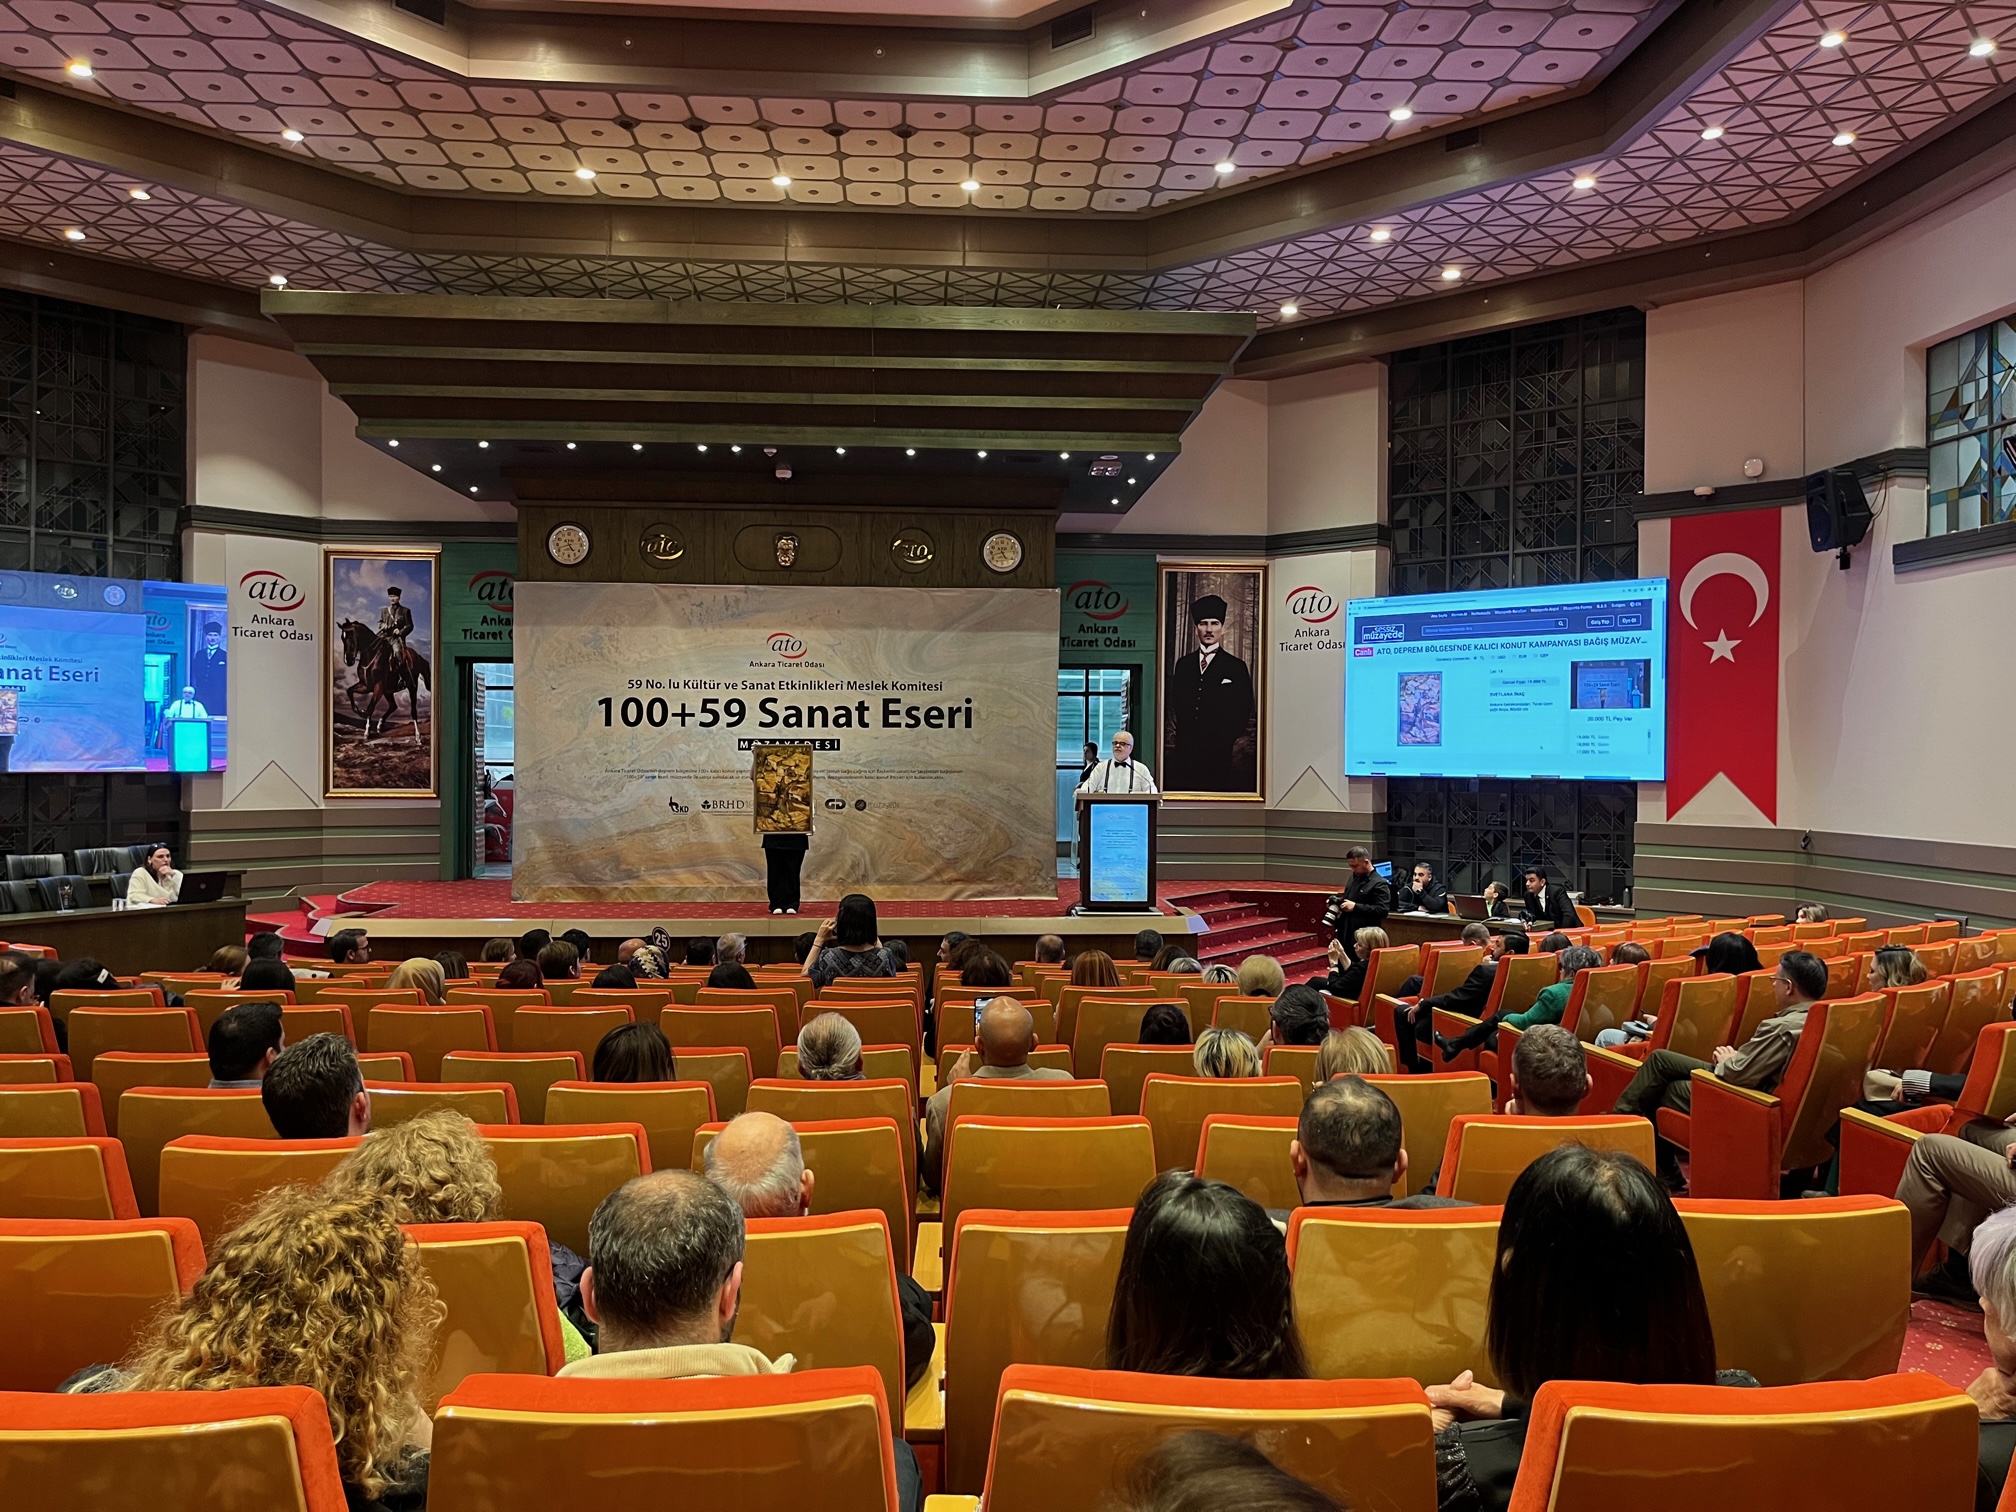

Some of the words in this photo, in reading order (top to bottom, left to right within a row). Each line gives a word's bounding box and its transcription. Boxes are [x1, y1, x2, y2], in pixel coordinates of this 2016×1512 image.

[249, 577, 297, 602] ato
[1075, 587, 1121, 610] ato
[1292, 592, 1332, 615] ato
[251, 614, 295, 627] Ankara
[481, 615, 514, 627] Anka
[232, 626, 274, 640] Ticaret
[279, 629, 313, 642] Odası
[462, 628, 503, 640] Ticaret
[1078, 623, 1118, 634] Ankara
[1294, 627, 1330, 638] Ankara
[1363, 629, 1403, 640] müzayede
[772, 637, 802, 652] ato
[1060, 636, 1099, 648] Ticaret
[1104, 637, 1136, 648] Odası
[1279, 641, 1313, 652] Ticaret
[1394, 646, 1423, 654] DEPREM
[1474, 642, 1498, 651] KALICI
[1501, 641, 1527, 649] KONUT
[1529, 638, 1581, 648] KAMPANYASI
[1584, 637, 1609, 646] BAĞIŞ
[1355, 648, 1372, 656] Canlı
[29, 655, 52, 663] Meslek
[0, 666, 42, 681] anat
[49, 666, 99, 682] Eseri
[628, 679, 643, 689] 59
[646, 679, 665, 689] No.
[668, 679, 680, 689] lu
[683, 679, 721, 690] Kültür
[724, 681, 739, 690] ve
[741, 680, 775, 690] Sanat
[778, 680, 844, 691] Etkinlikleri
[847, 680, 889, 691] Meslek
[892, 680, 943, 692] Komitesi
[597, 697, 747, 729] 100+59
[758, 697, 870, 729] Sanat
[882, 697, 973, 729] Eseri
[655, 932, 668, 948] 25
